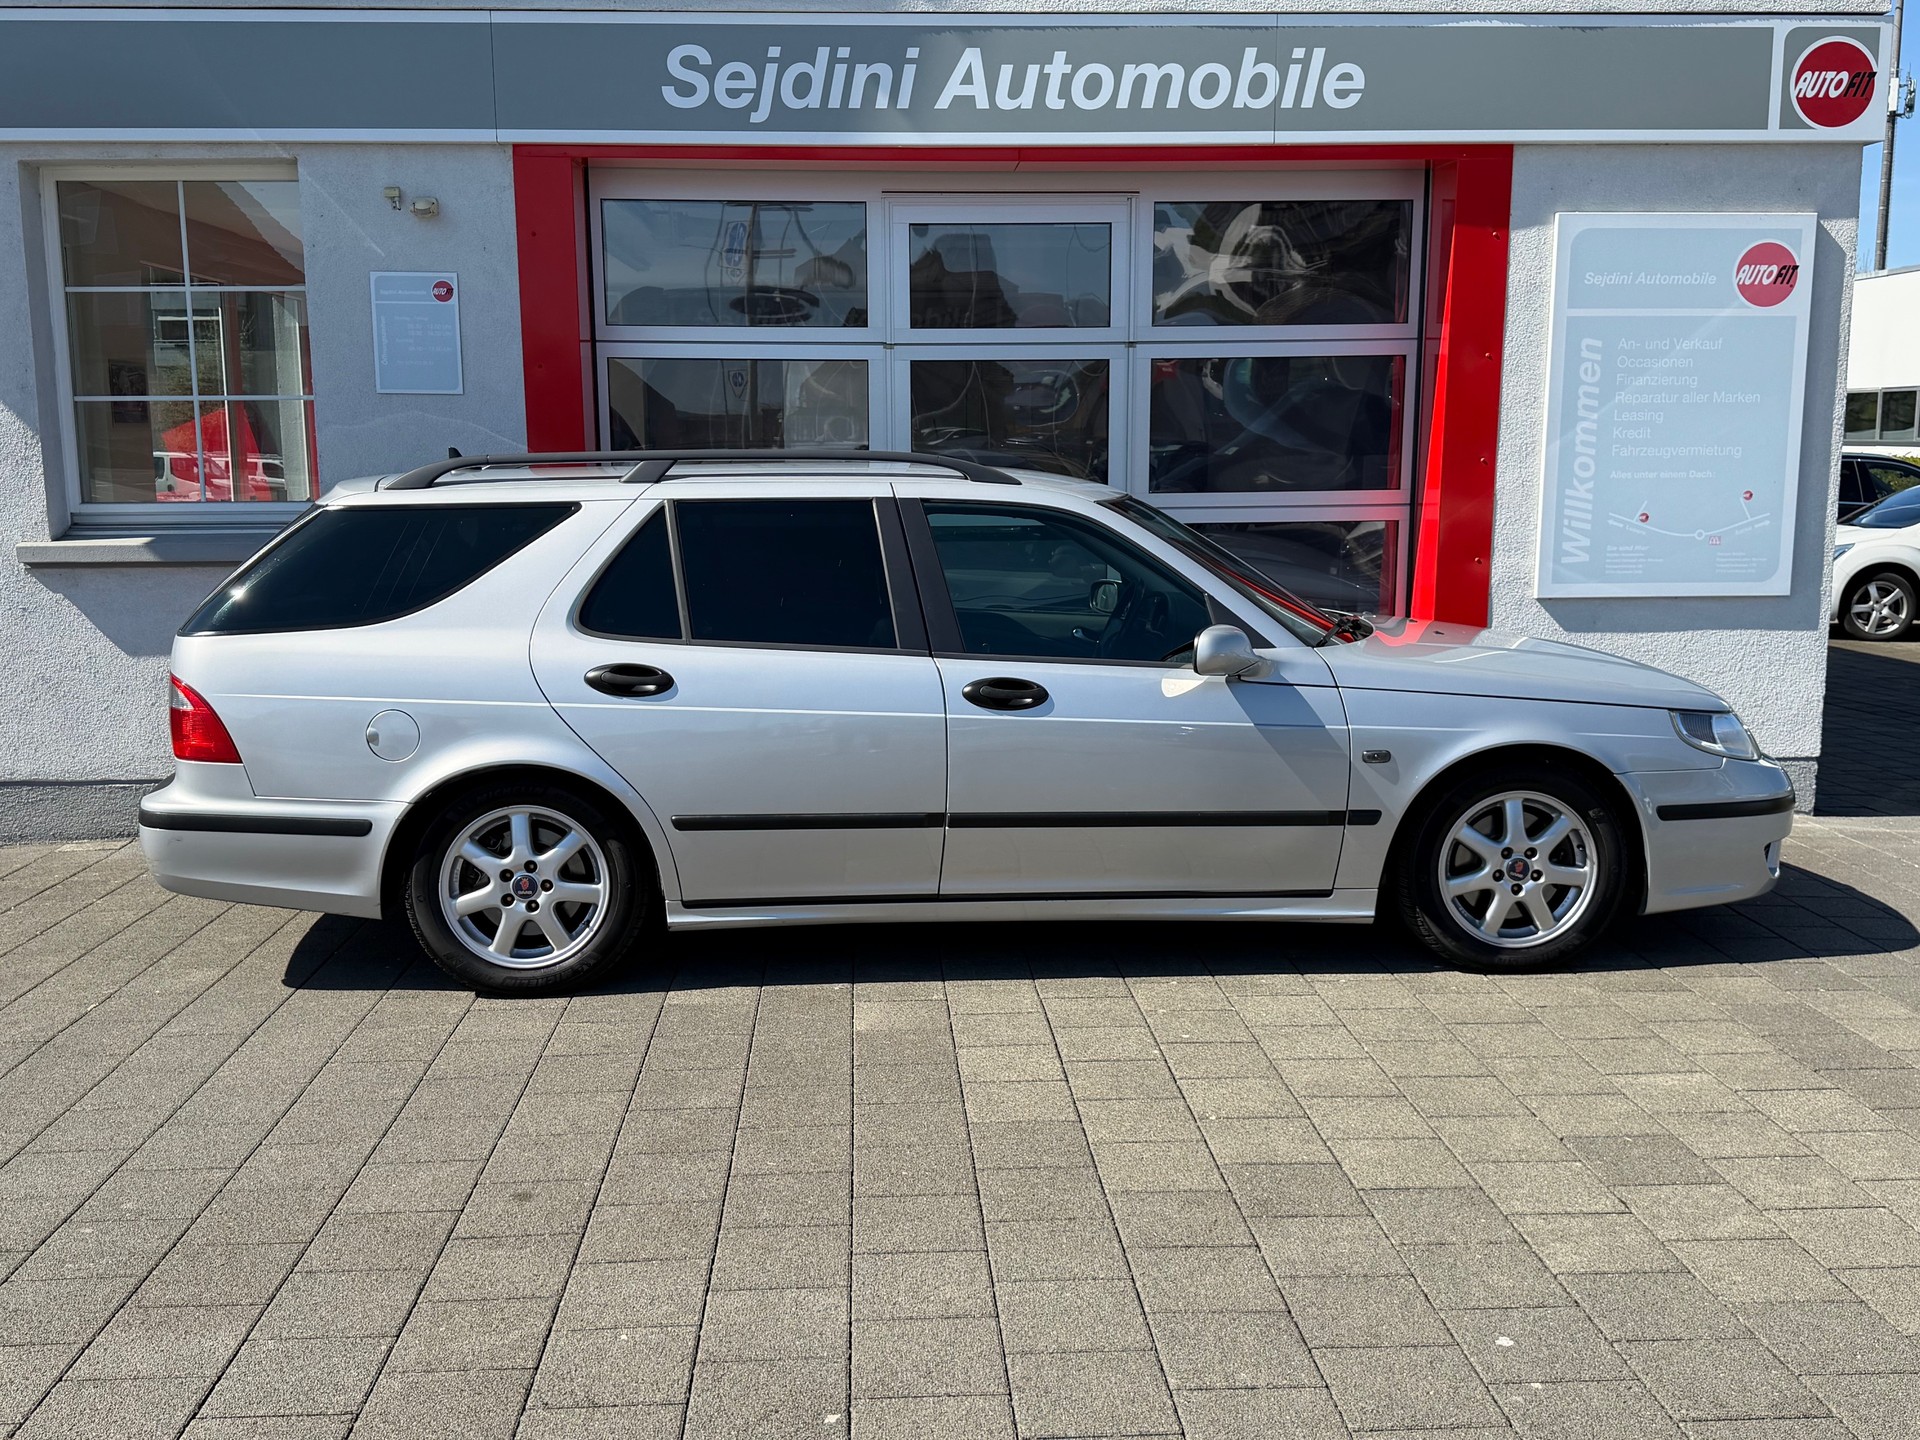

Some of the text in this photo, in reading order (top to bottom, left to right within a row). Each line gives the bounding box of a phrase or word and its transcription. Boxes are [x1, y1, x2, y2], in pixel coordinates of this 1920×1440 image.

[661, 44, 1366, 124] Sejdini Automobile
[1584, 272, 1717, 288] Sejdini Automobile
[1618, 337, 1723, 350] An- und Verkauf
[1617, 356, 1694, 368] Occasionen
[1616, 374, 1698, 388] Finanzierung
[1615, 391, 1761, 406] Reparatur aller Marken
[1614, 409, 1664, 424] Leasing
[1613, 427, 1652, 439] Kredit
[1560, 337, 1603, 564] Willkommen
[1611, 444, 1743, 460] Fahrzeugvermietung
[1610, 470, 1632, 479] Alles
[1633, 470, 1658, 479] unter
[1659, 470, 1687, 479] einem
